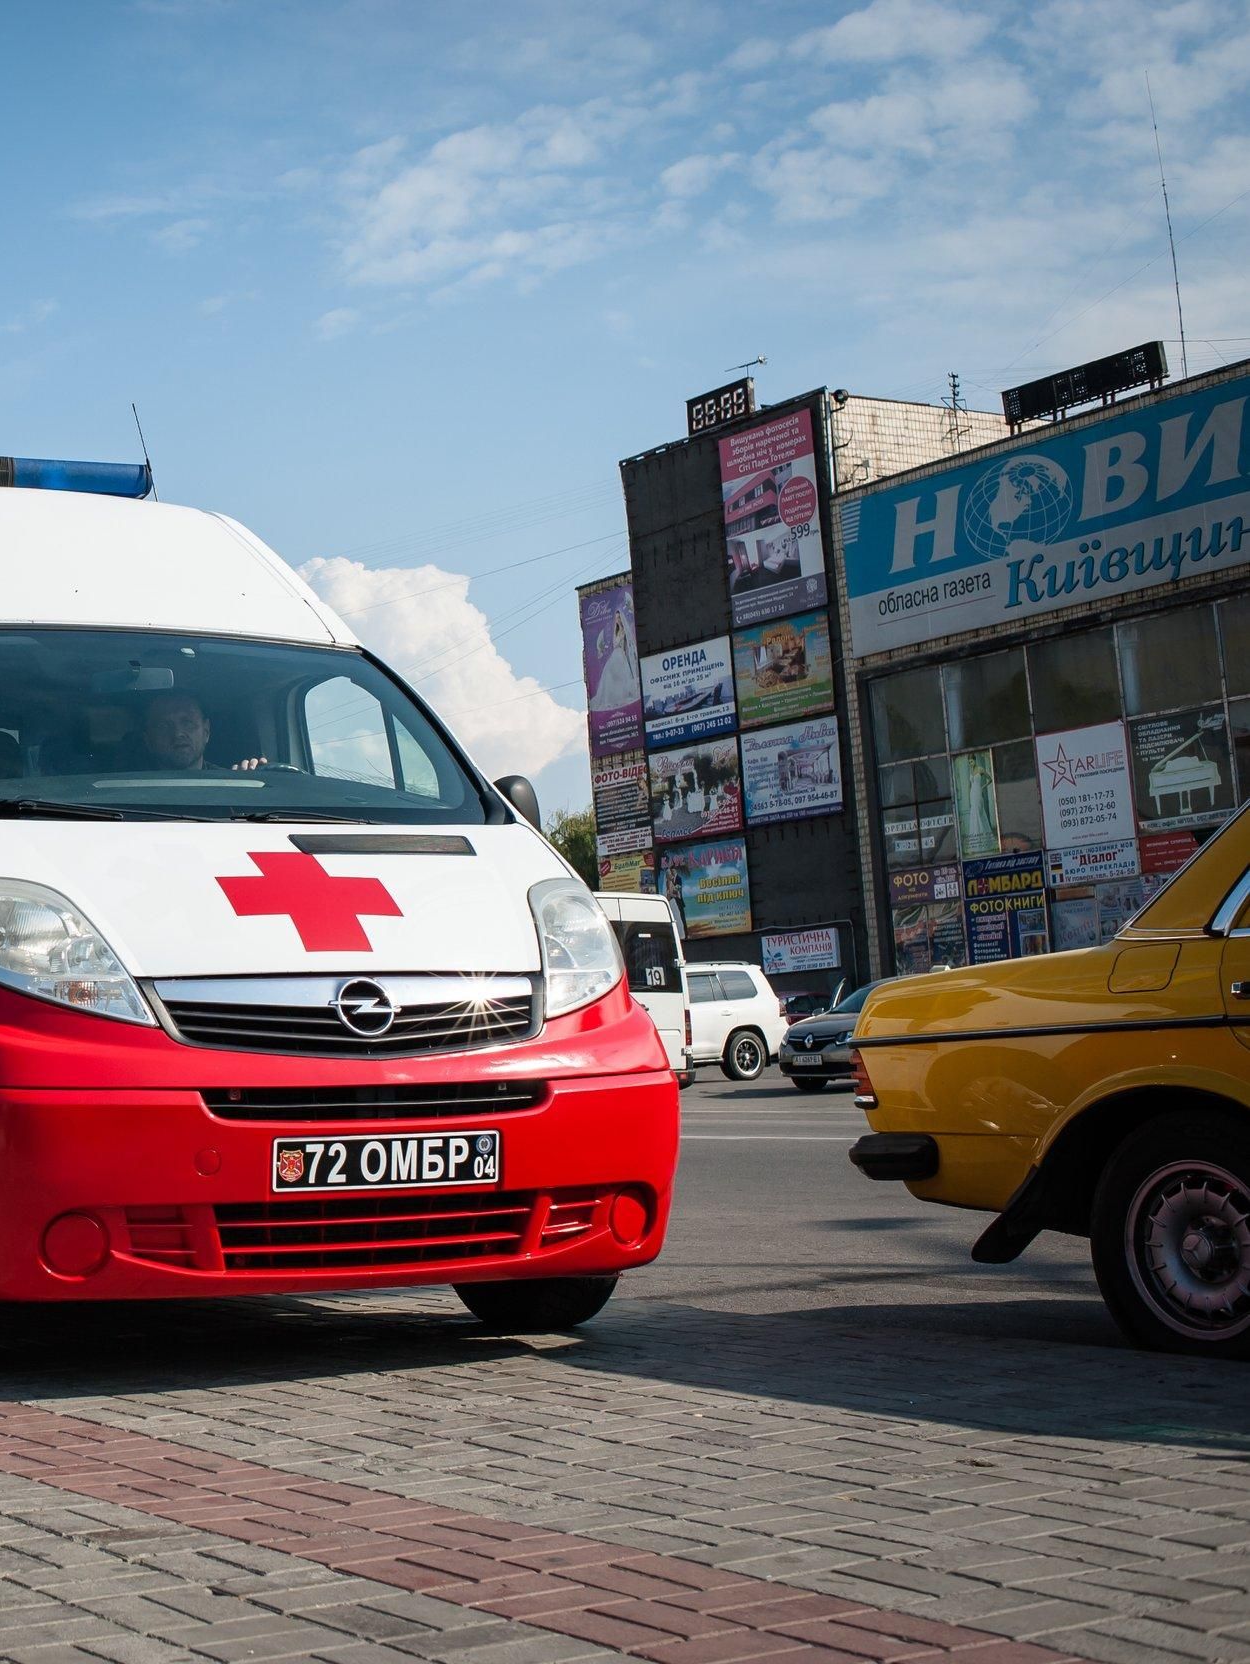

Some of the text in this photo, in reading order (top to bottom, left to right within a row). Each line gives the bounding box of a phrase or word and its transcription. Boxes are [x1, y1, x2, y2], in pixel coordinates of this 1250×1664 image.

[790, 523, 810, 540] 599
[878, 572, 991, 615] обласна газета
[662, 649, 707, 671] ОРЕНДА
[650, 661, 724, 684] ОФІСНИХ ПРИМІЩЕНЬ
[1058, 790, 1114, 806] (050) 181-17-73
[1059, 801, 1116, 818] (097) 276-12-60
[1060, 812, 1117, 829] (093) 872-05-74
[1064, 861, 1136, 875] БЮРО ПЕРЕКЛАДІВ
[700, 874, 741, 889] Весілля
[893, 871, 929, 888] ФОТО
[970, 895, 1045, 914] ФОТОКНИГИ
[766, 931, 831, 947] ТУРИСТИЧНА
[790, 942, 832, 955] КОМПАНІЯ
[648, 970, 662, 986] 19
[306, 1138, 469, 1184] 72 ОМБР
[474, 1155, 495, 1178] 04
